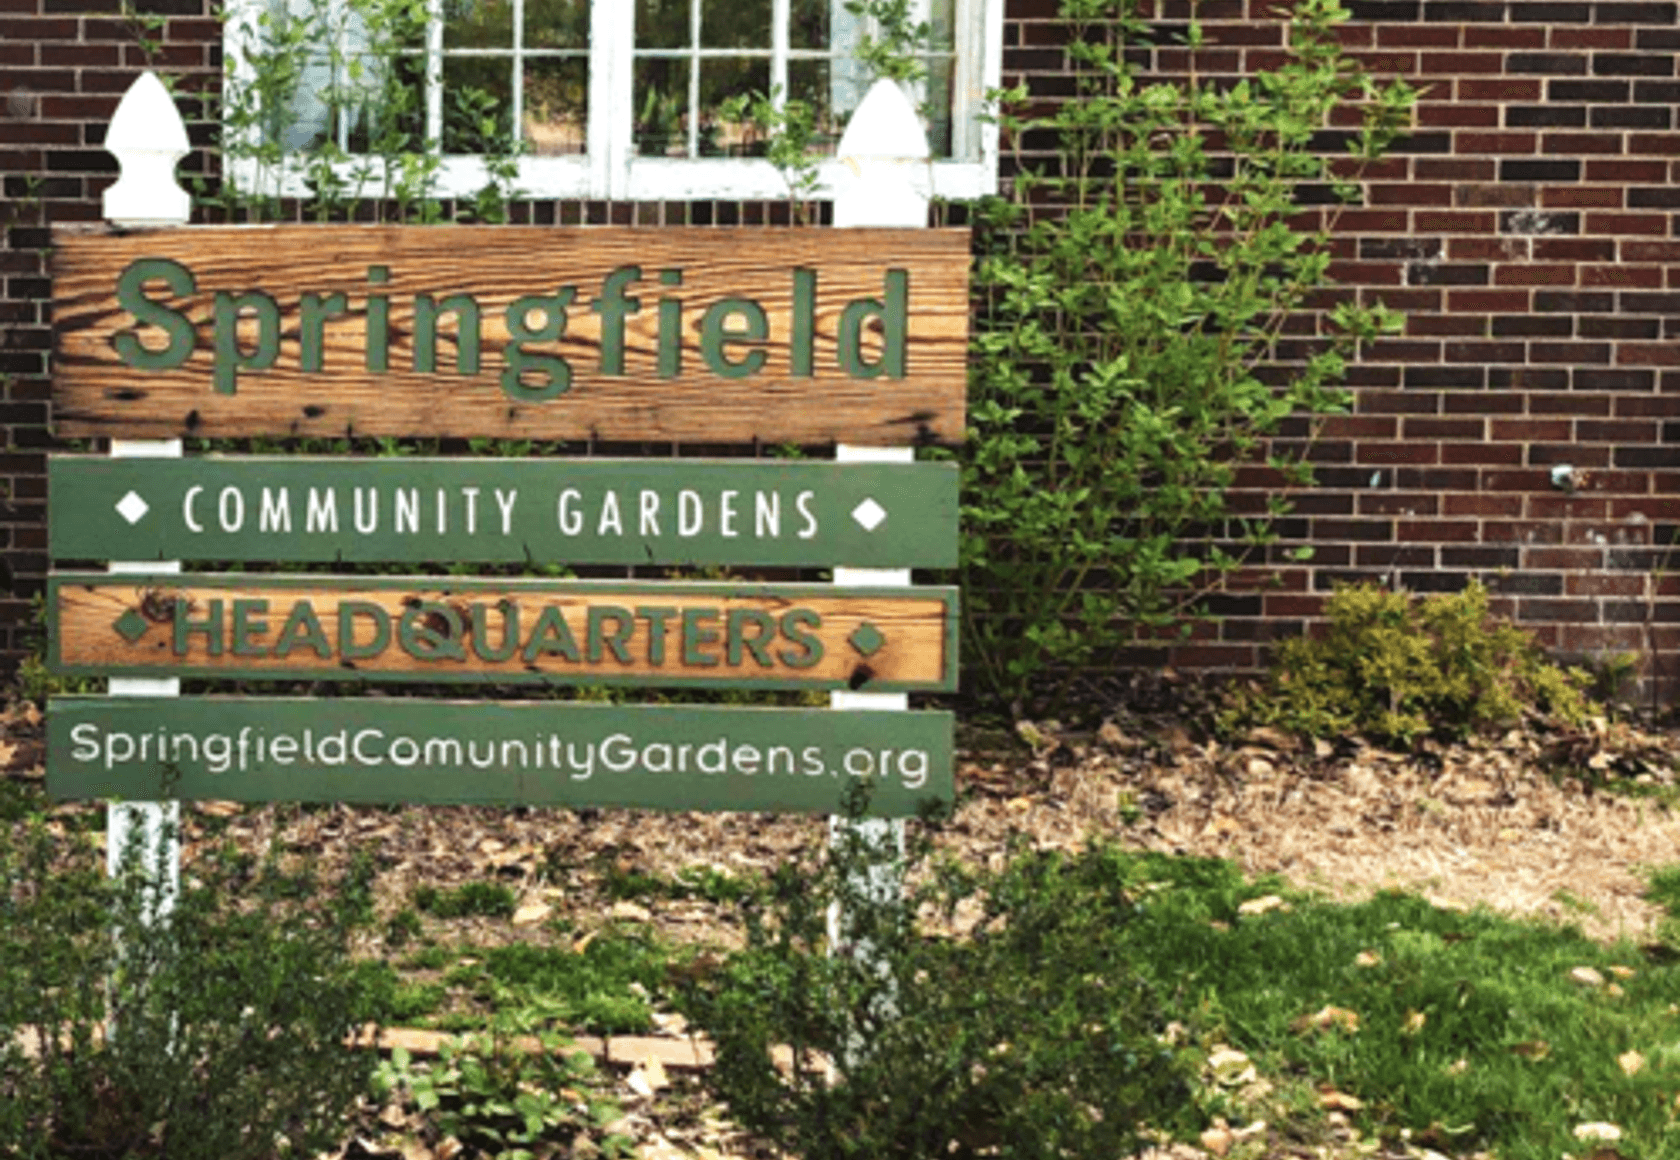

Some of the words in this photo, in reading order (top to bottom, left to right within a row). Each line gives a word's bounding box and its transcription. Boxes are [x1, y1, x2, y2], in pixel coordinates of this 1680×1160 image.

[113, 256, 909, 402] Springfield
[183, 486, 518, 536] COMMUNITY
[558, 487, 819, 538] GARDENS
[171, 598, 826, 669] HEADQUARTERS
[69, 722, 930, 788] SpringfieldComunityGardens.org
